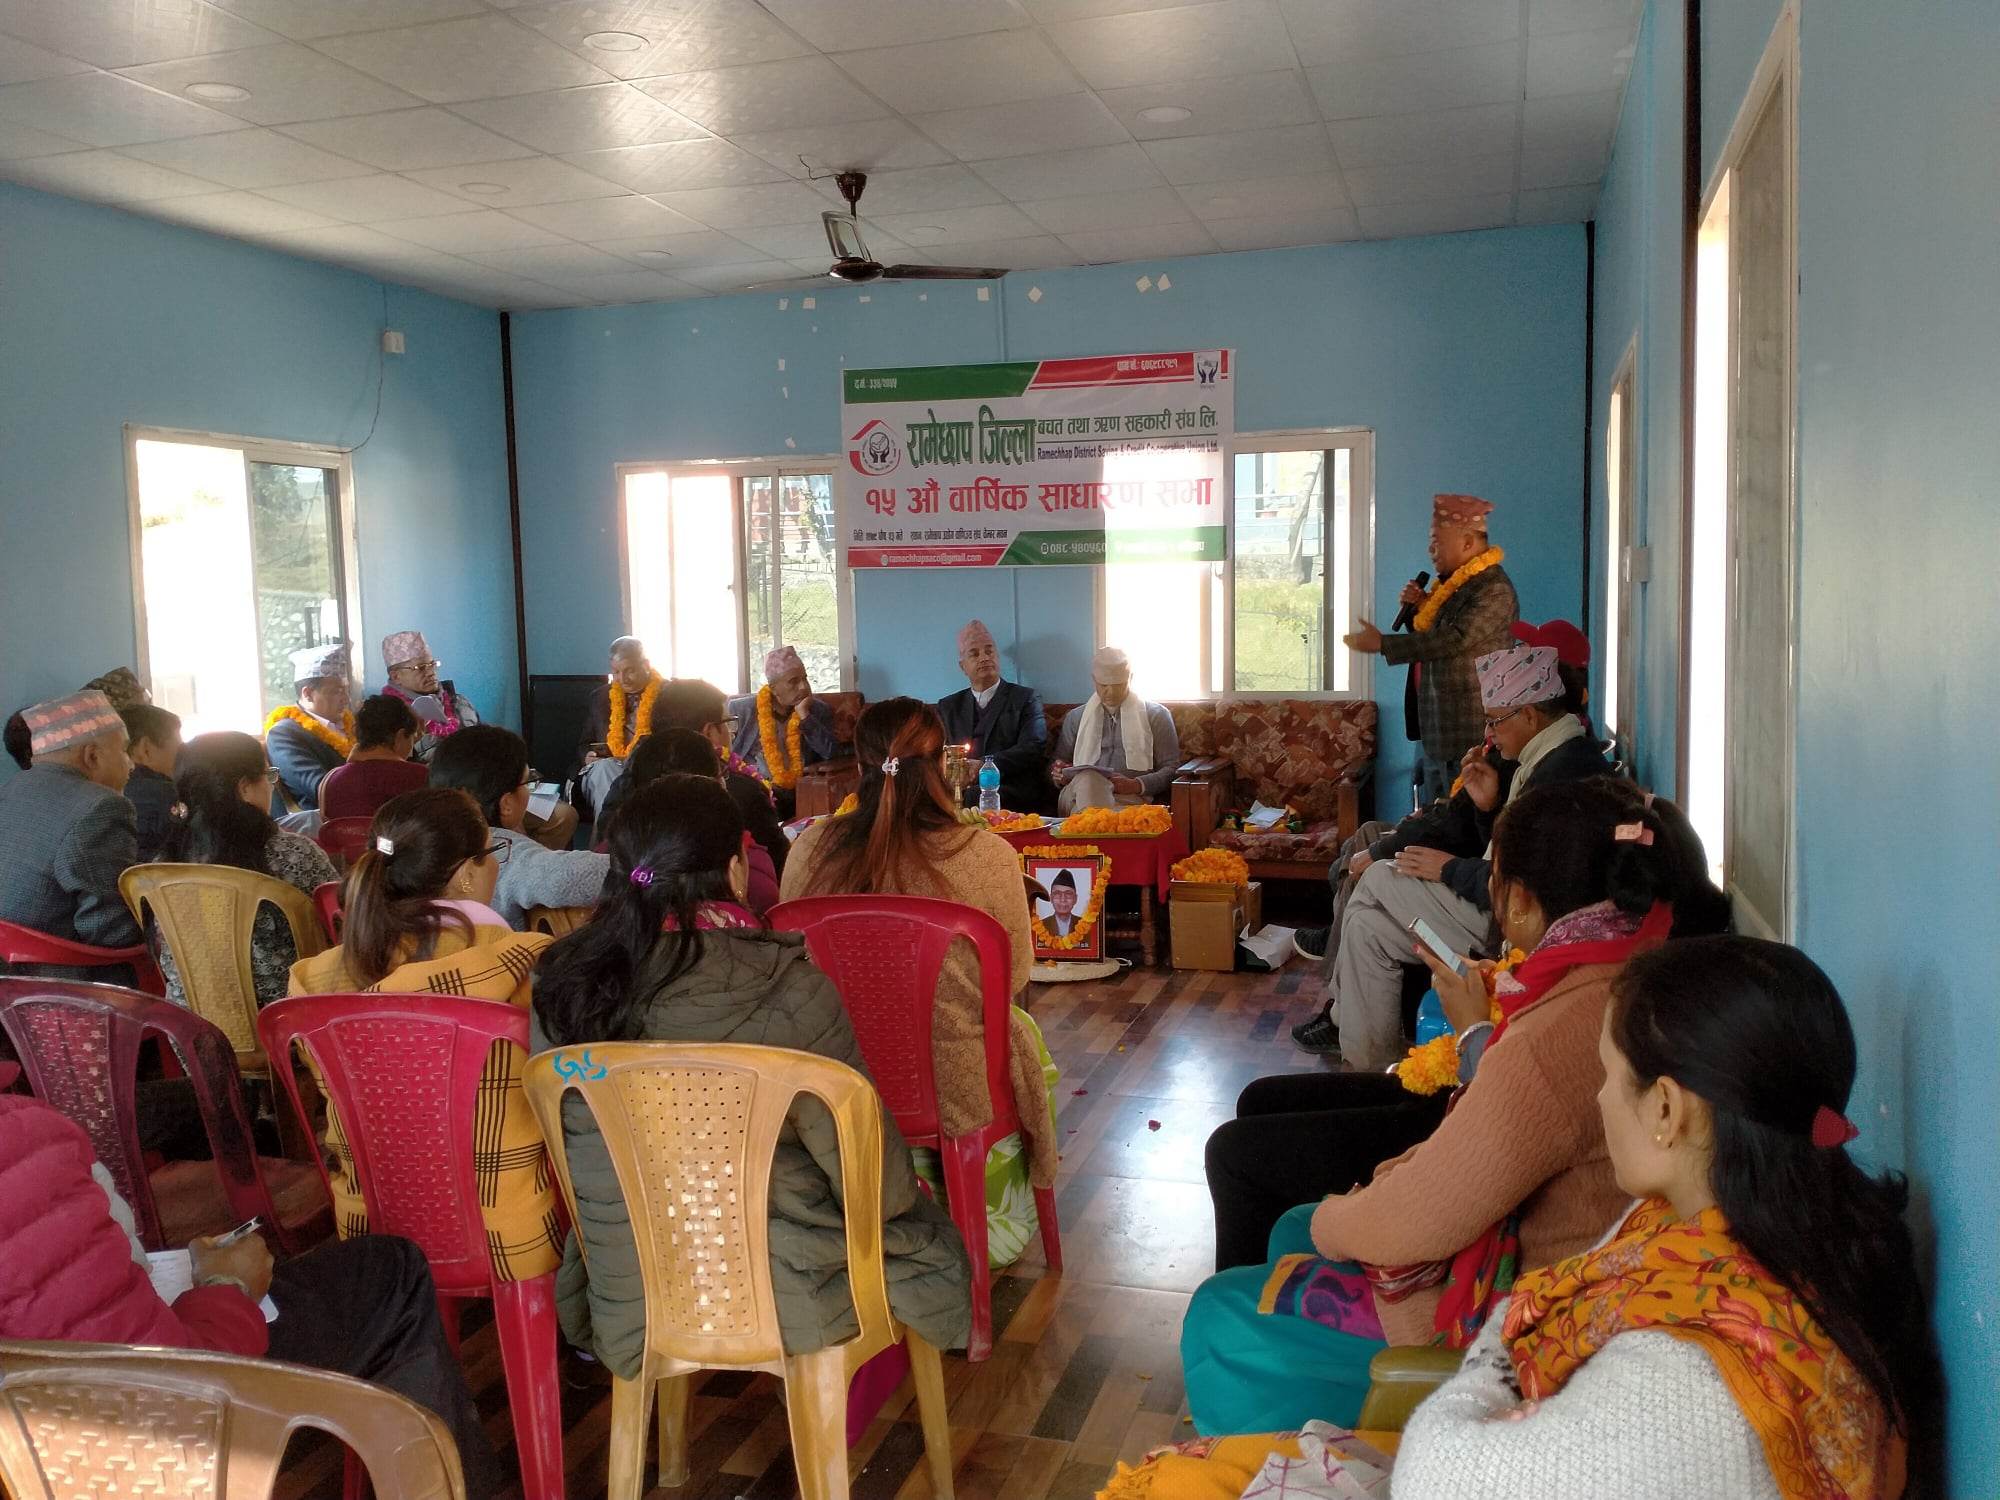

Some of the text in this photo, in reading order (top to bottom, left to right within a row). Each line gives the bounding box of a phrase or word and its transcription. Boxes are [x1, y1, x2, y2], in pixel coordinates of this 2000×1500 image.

[906, 408, 973, 468] रामेछाप
[979, 404, 1036, 466] जिल्ला
[1038, 419, 1063, 434] बचत
[1067, 417, 1090, 434] तथा
[1125, 408, 1171, 432] सहकारी
[1175, 409, 1196, 429] संघ
[1200, 405, 1218, 427] लि.
[1037, 446, 1073, 462] Ramechhap
[1074, 444, 1096, 458] District
[866, 489, 896, 516] १५
[949, 476, 1029, 512] वार्षिक
[1038, 482, 1144, 512] साधारण
